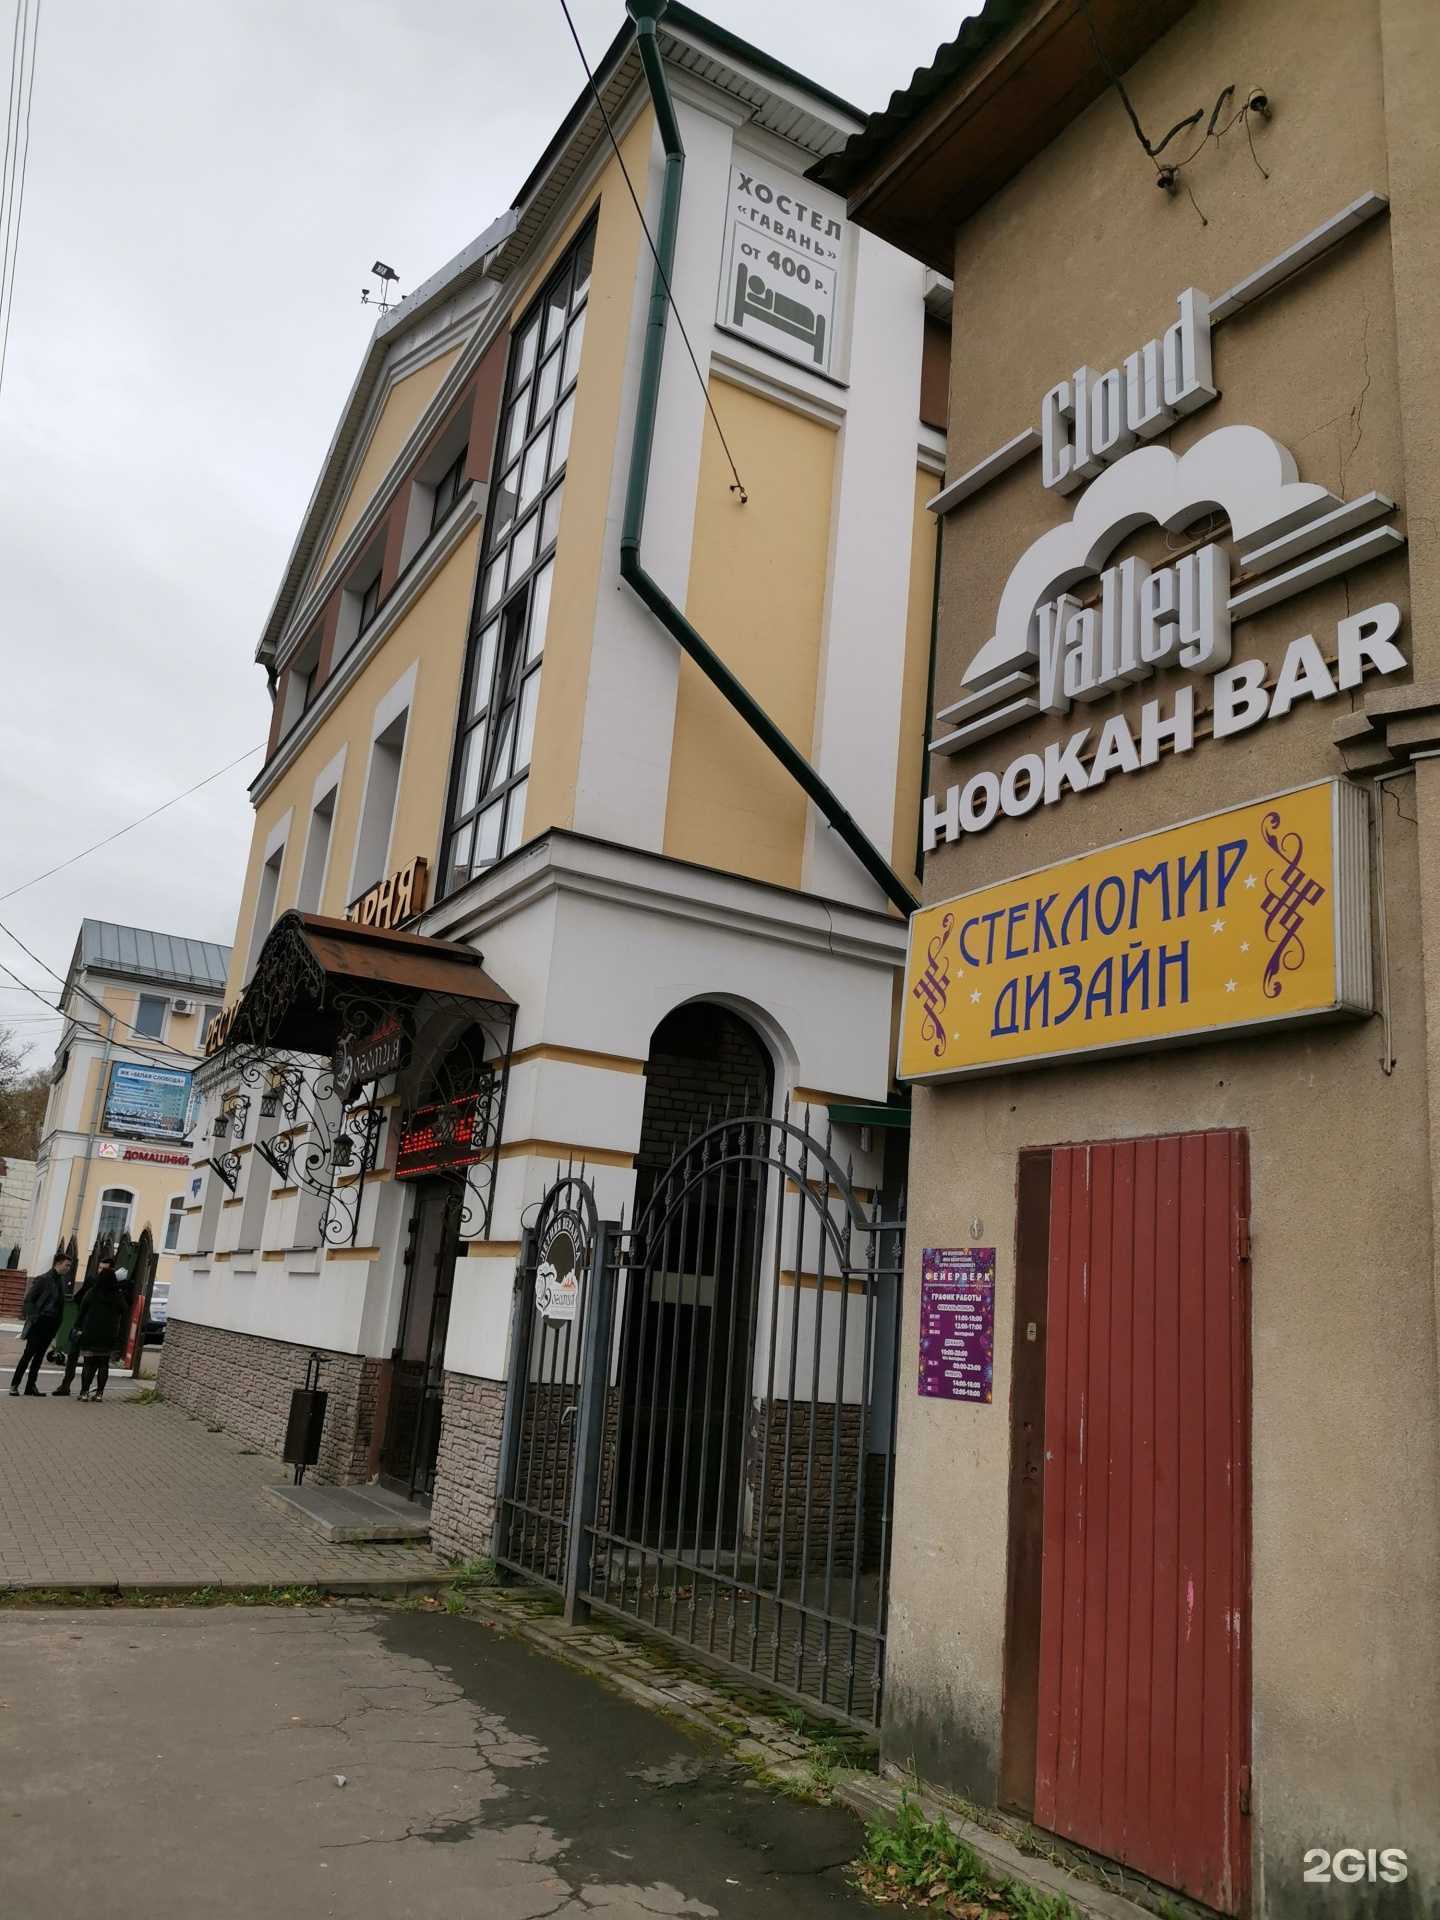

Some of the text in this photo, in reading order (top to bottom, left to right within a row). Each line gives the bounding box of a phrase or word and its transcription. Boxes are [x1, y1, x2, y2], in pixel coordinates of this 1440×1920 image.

[737, 172, 842, 241] ХОСТЕЛ
[737, 204, 837, 259] «ГАВАНЬ»
[767, 250, 811, 285] 400
[1041, 286, 1214, 492] Cloud
[1036, 543, 1231, 714] Valley
[922, 602, 1408, 851] HOOKAH BAR
[959, 838, 1248, 967] СТЕКЛОМИР
[990, 940, 1190, 1038] ДИЗАЙН
[122, 1150, 190, 1166] ДОМАШНИЙ
